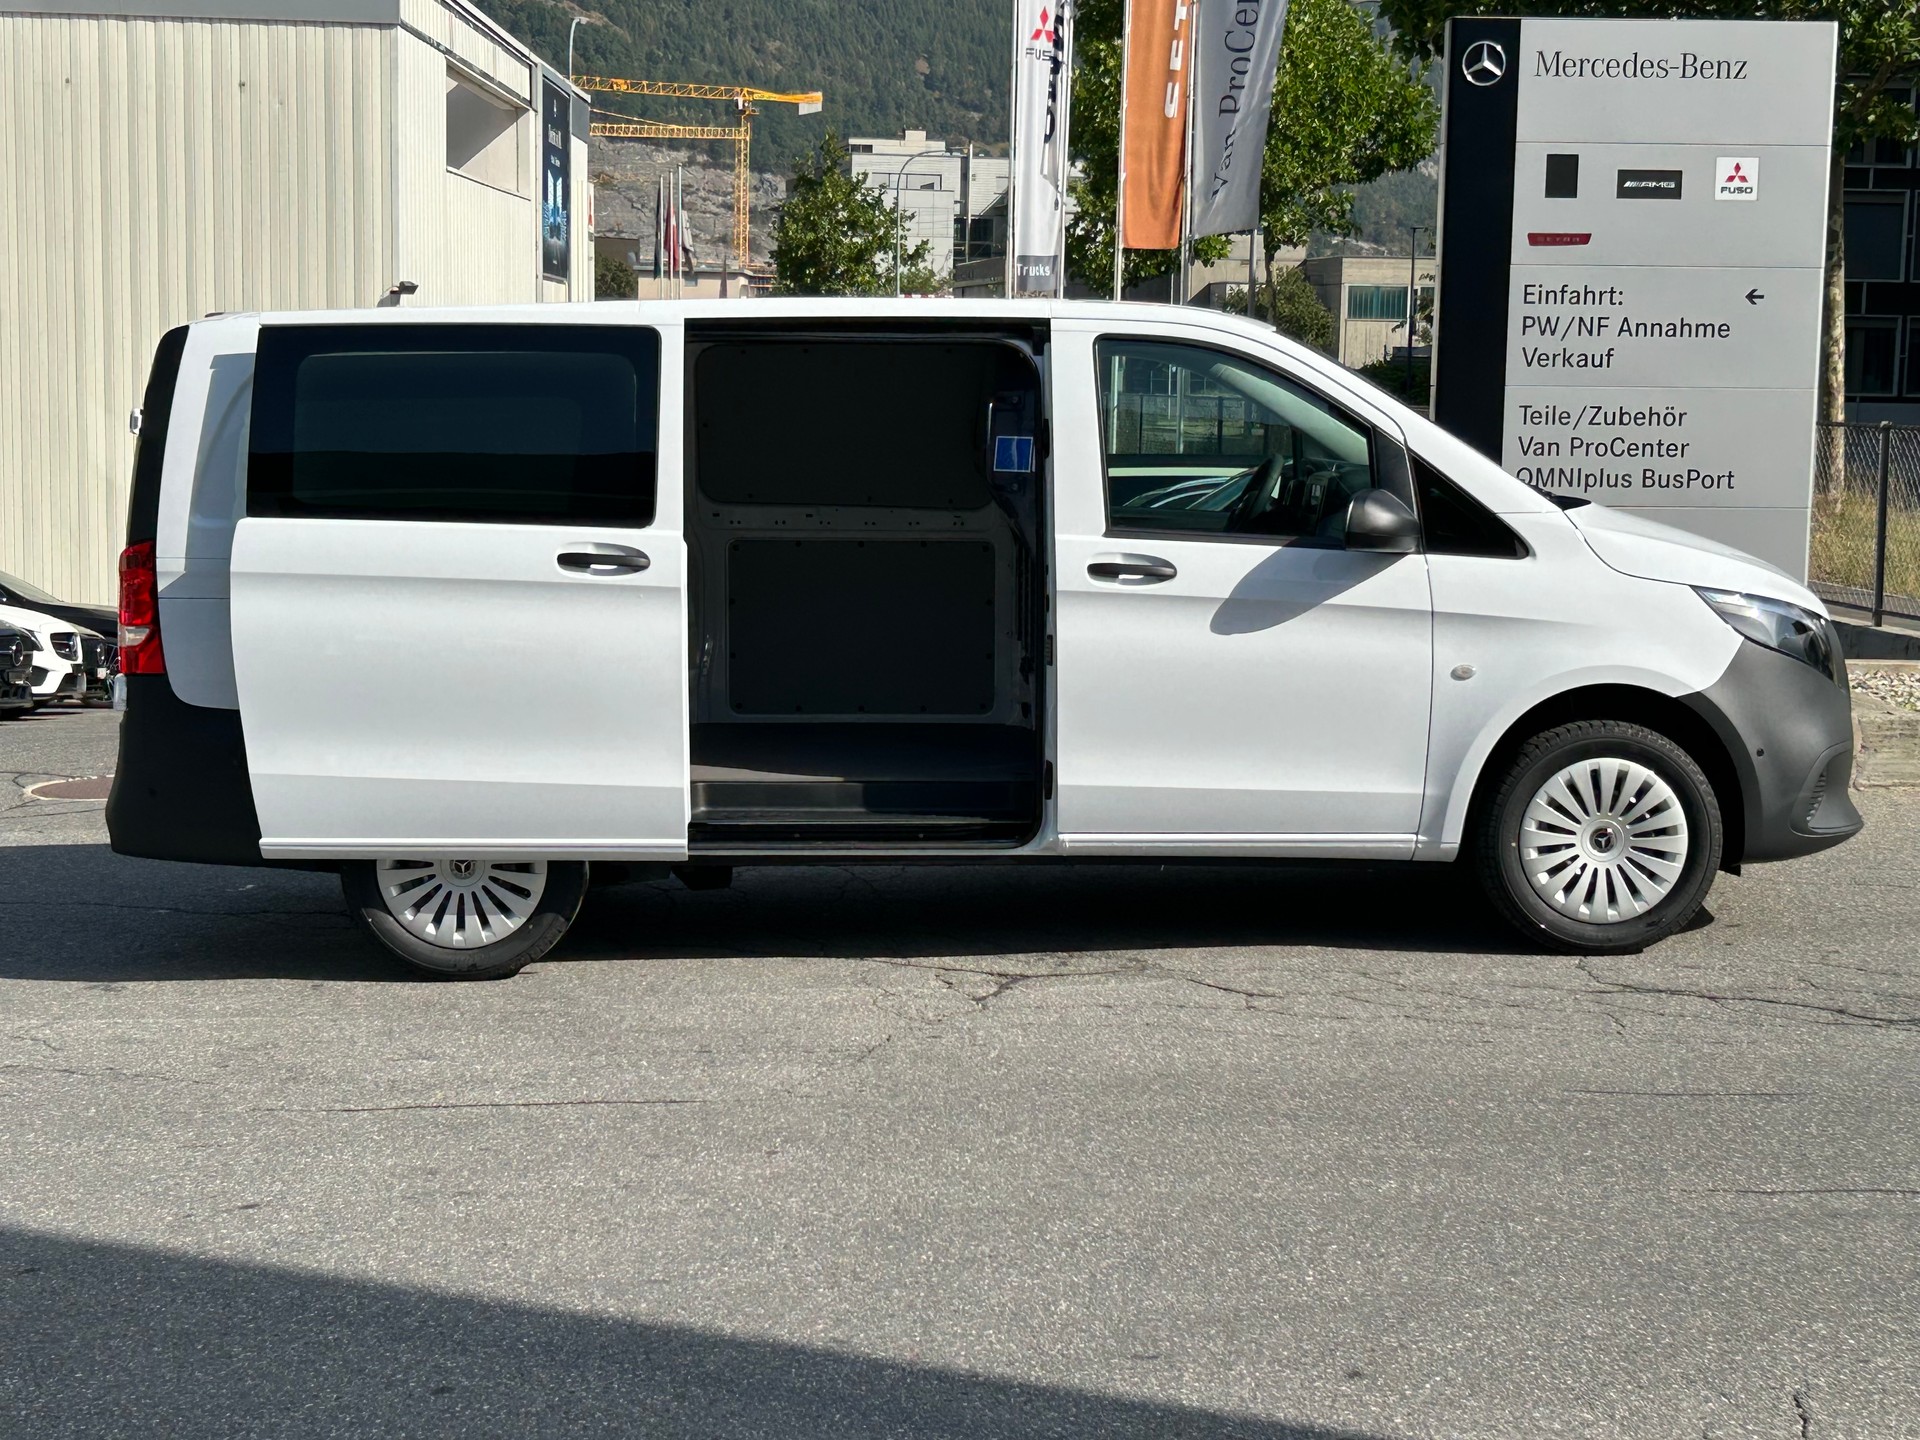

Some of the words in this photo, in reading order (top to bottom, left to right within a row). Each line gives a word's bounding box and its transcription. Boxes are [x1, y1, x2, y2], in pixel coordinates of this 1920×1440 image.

[1025, 47, 1053, 61] FUS
[1218, 0, 1261, 118] ProCe
[1534, 50, 1748, 80] Mercedes-Benz
[1720, 186, 1754, 195] FUSO
[1016, 263, 1051, 277] Trucks
[1523, 284, 1624, 306] Einfahrt:
[1521, 316, 1610, 342] PW/NF
[1617, 317, 1731, 338] Annahme
[1522, 347, 1615, 368] Verkauf
[1519, 405, 1687, 430] Teile/Zubehör
[1518, 436, 1560, 457] Van
[1570, 437, 1690, 458] ProCenter
[1516, 467, 1633, 493] OMNIplus
[1642, 469, 1735, 490] BusPort
